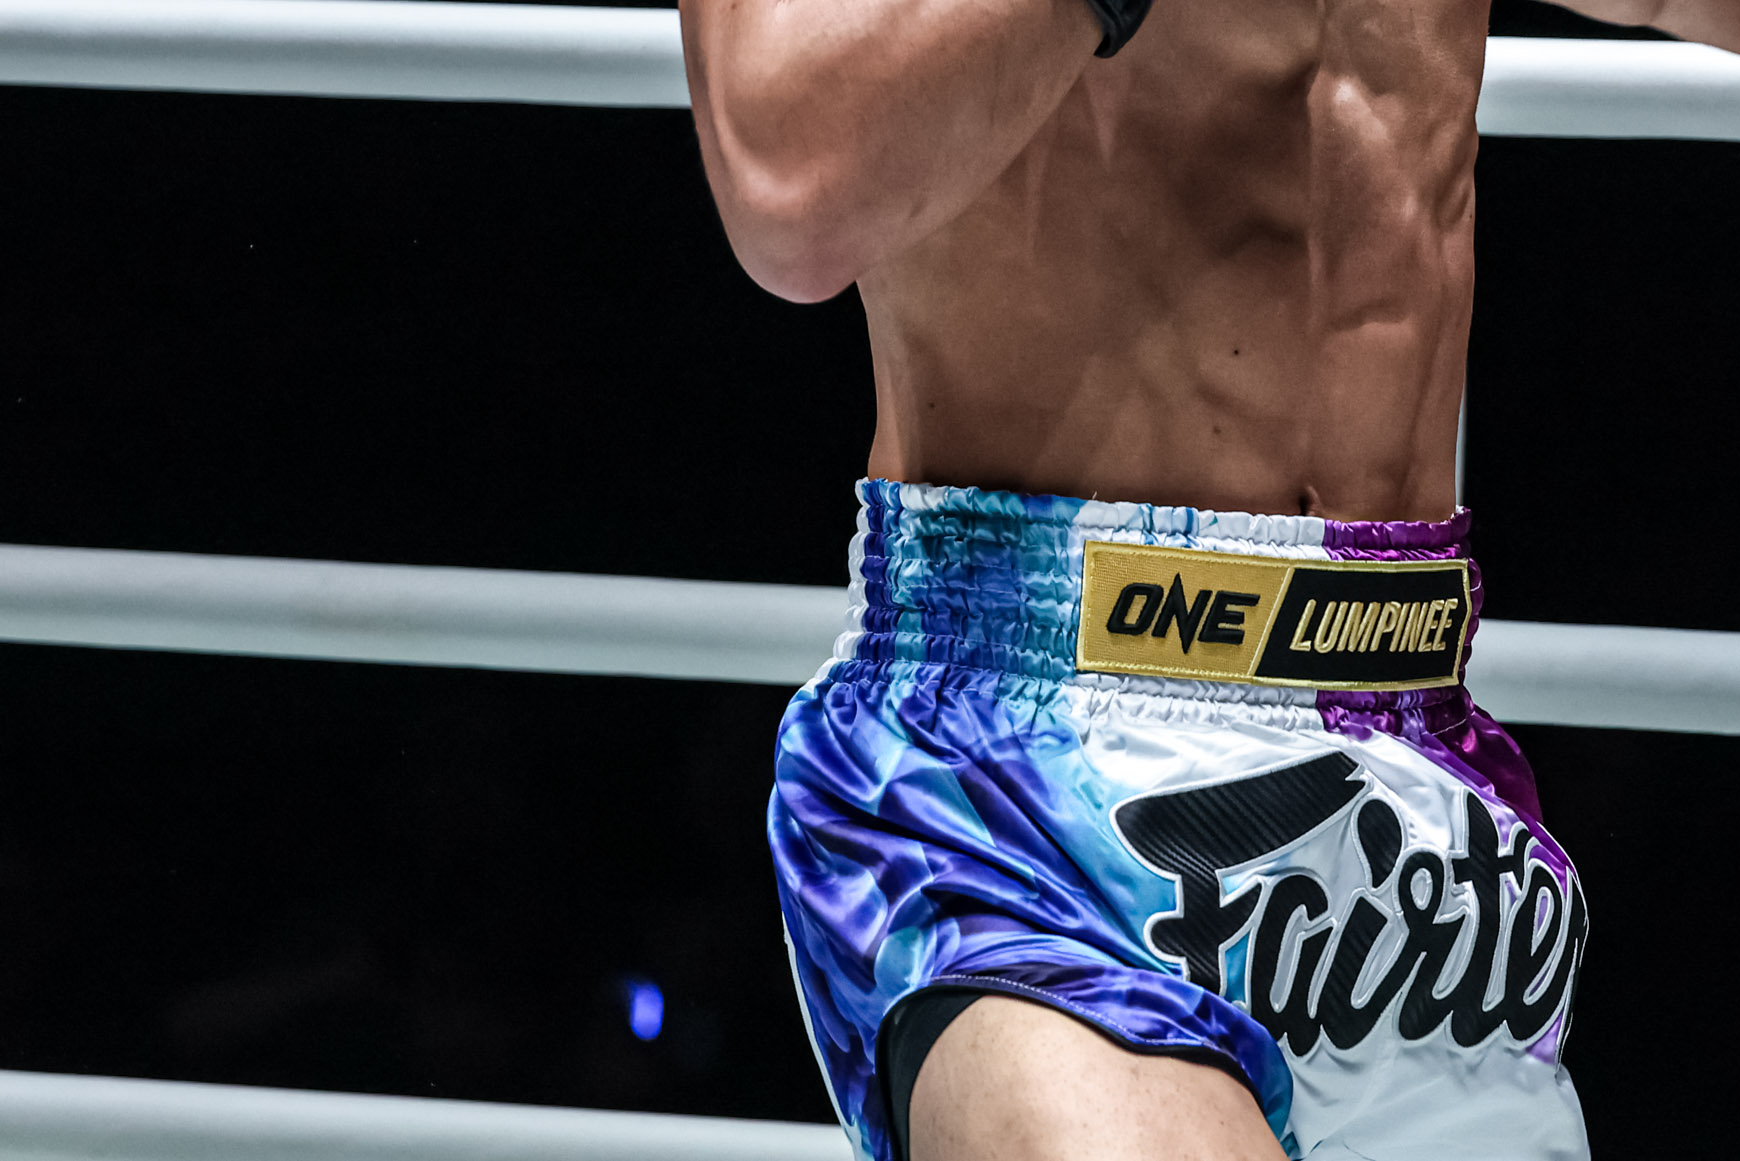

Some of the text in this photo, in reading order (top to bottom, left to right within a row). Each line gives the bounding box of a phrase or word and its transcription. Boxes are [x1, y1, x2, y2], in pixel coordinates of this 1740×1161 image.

[1106, 572, 1458, 654] ONE LUMPINEE
[1111, 749, 1588, 1060] Fairte
